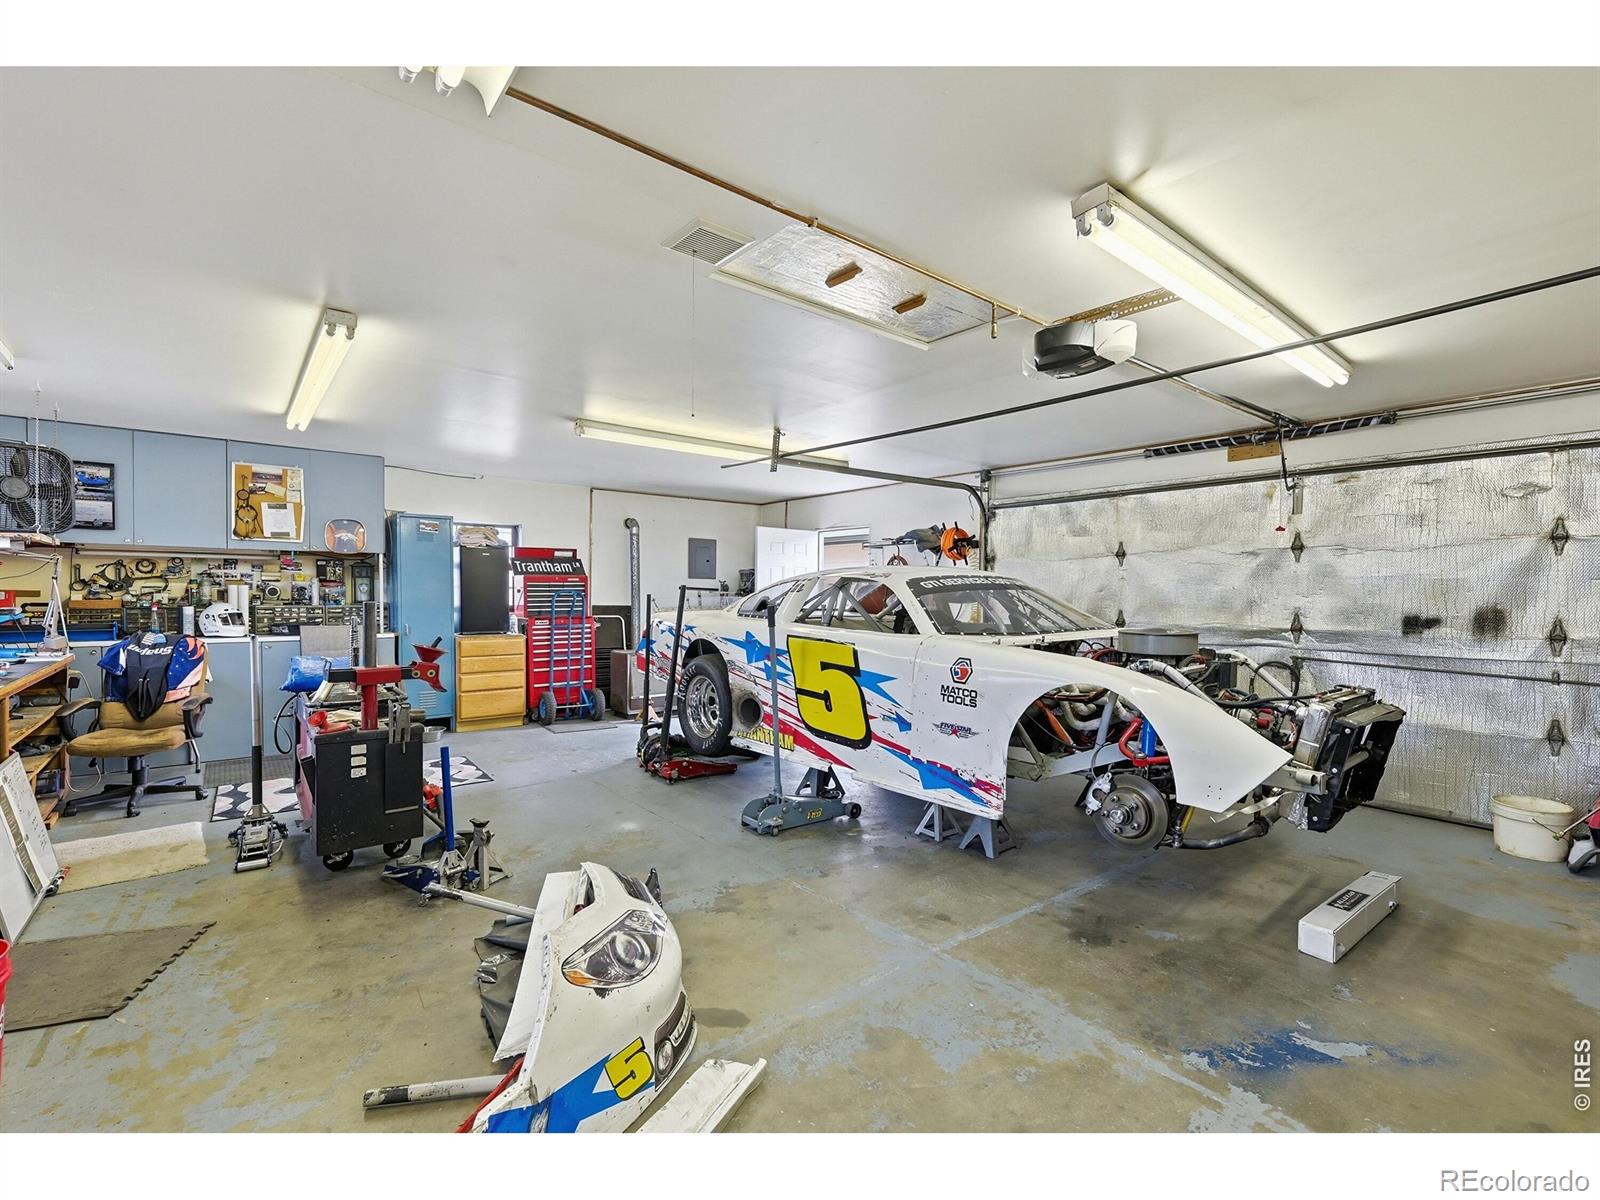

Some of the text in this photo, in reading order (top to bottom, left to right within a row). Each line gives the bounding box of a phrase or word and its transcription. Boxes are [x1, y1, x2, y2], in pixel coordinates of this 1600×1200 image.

[514, 561, 573, 573] Trantham
[787, 635, 872, 750] 5
[940, 684, 978, 699] MATCO
[940, 693, 978, 708] TOOLS
[604, 1036, 655, 1101] 5
